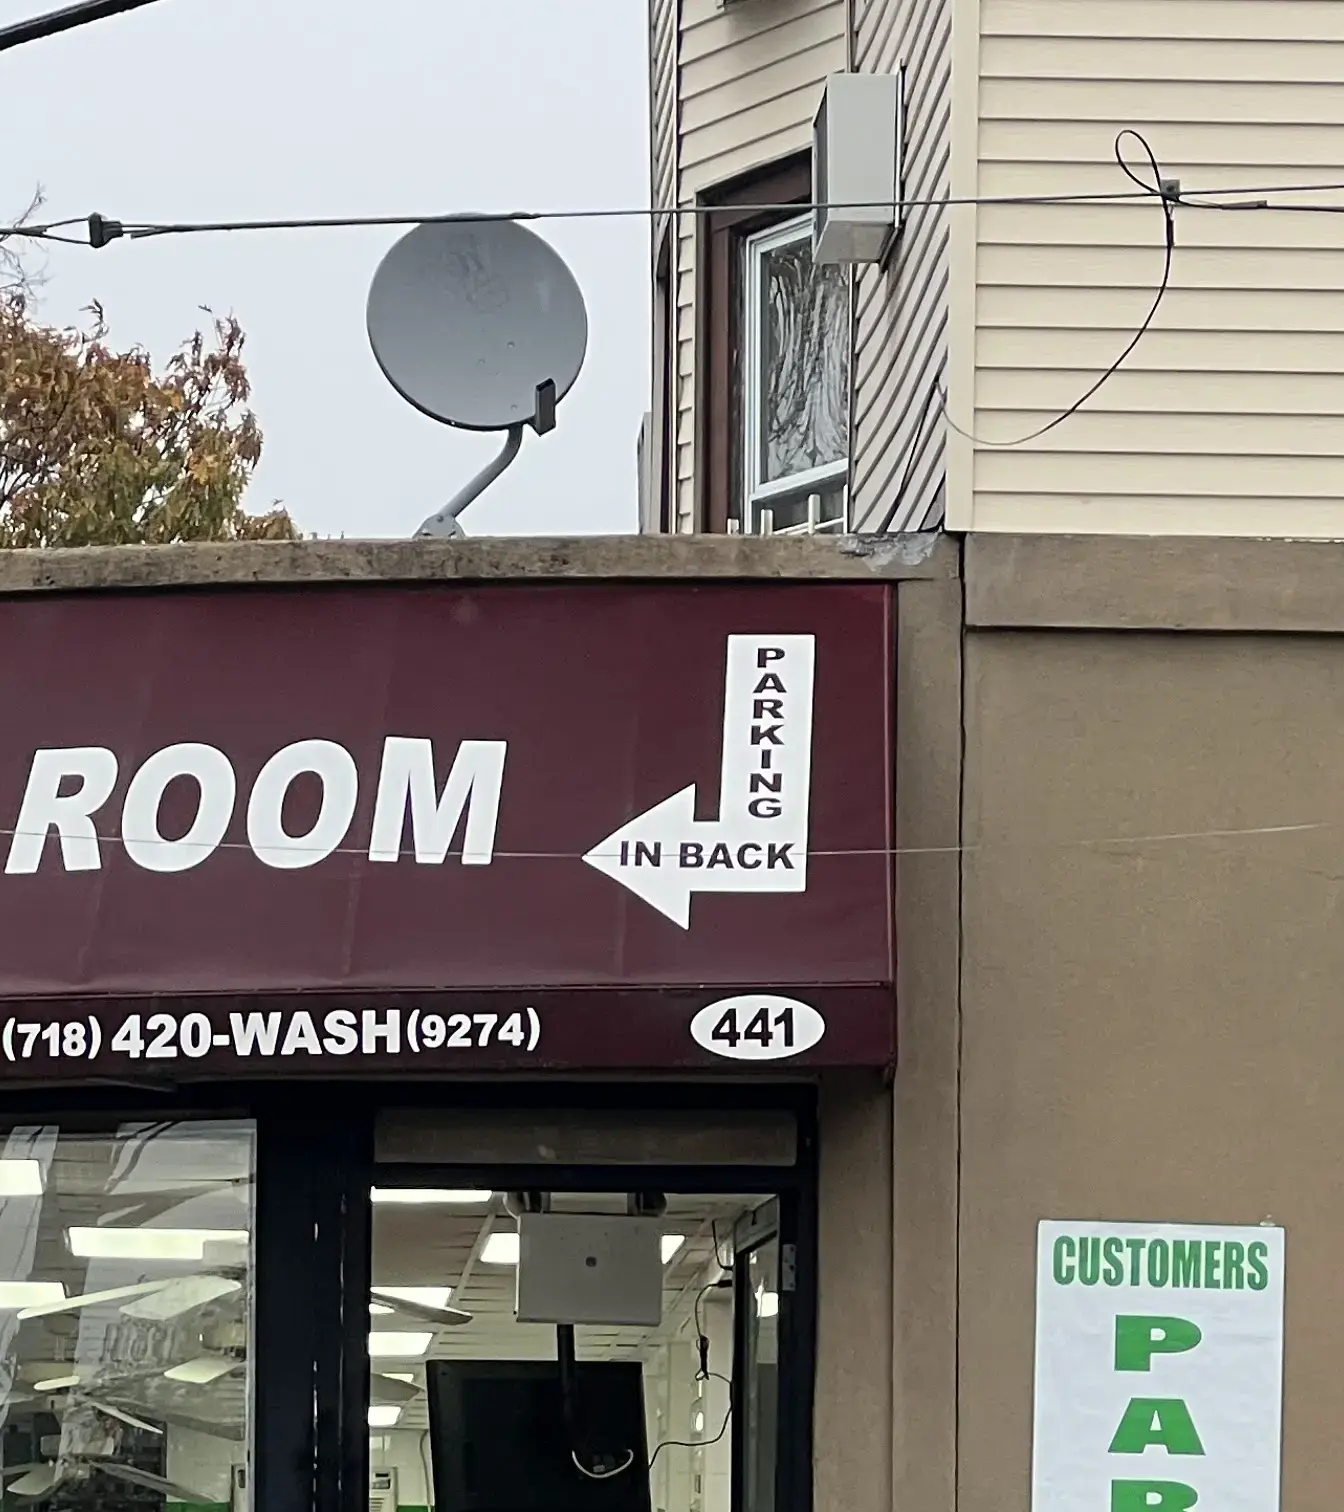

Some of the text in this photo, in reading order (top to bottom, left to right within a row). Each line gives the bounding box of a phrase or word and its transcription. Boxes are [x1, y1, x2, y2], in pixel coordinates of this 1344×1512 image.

[748, 647, 787, 820] PARKING
[4, 737, 508, 875] ROOM
[620, 841, 796, 871] IN BACK
[1, 1015, 101, 1062] (718)
[710, 1006, 796, 1049] 441
[1053, 1235, 1269, 1292] CUSTOMERS
